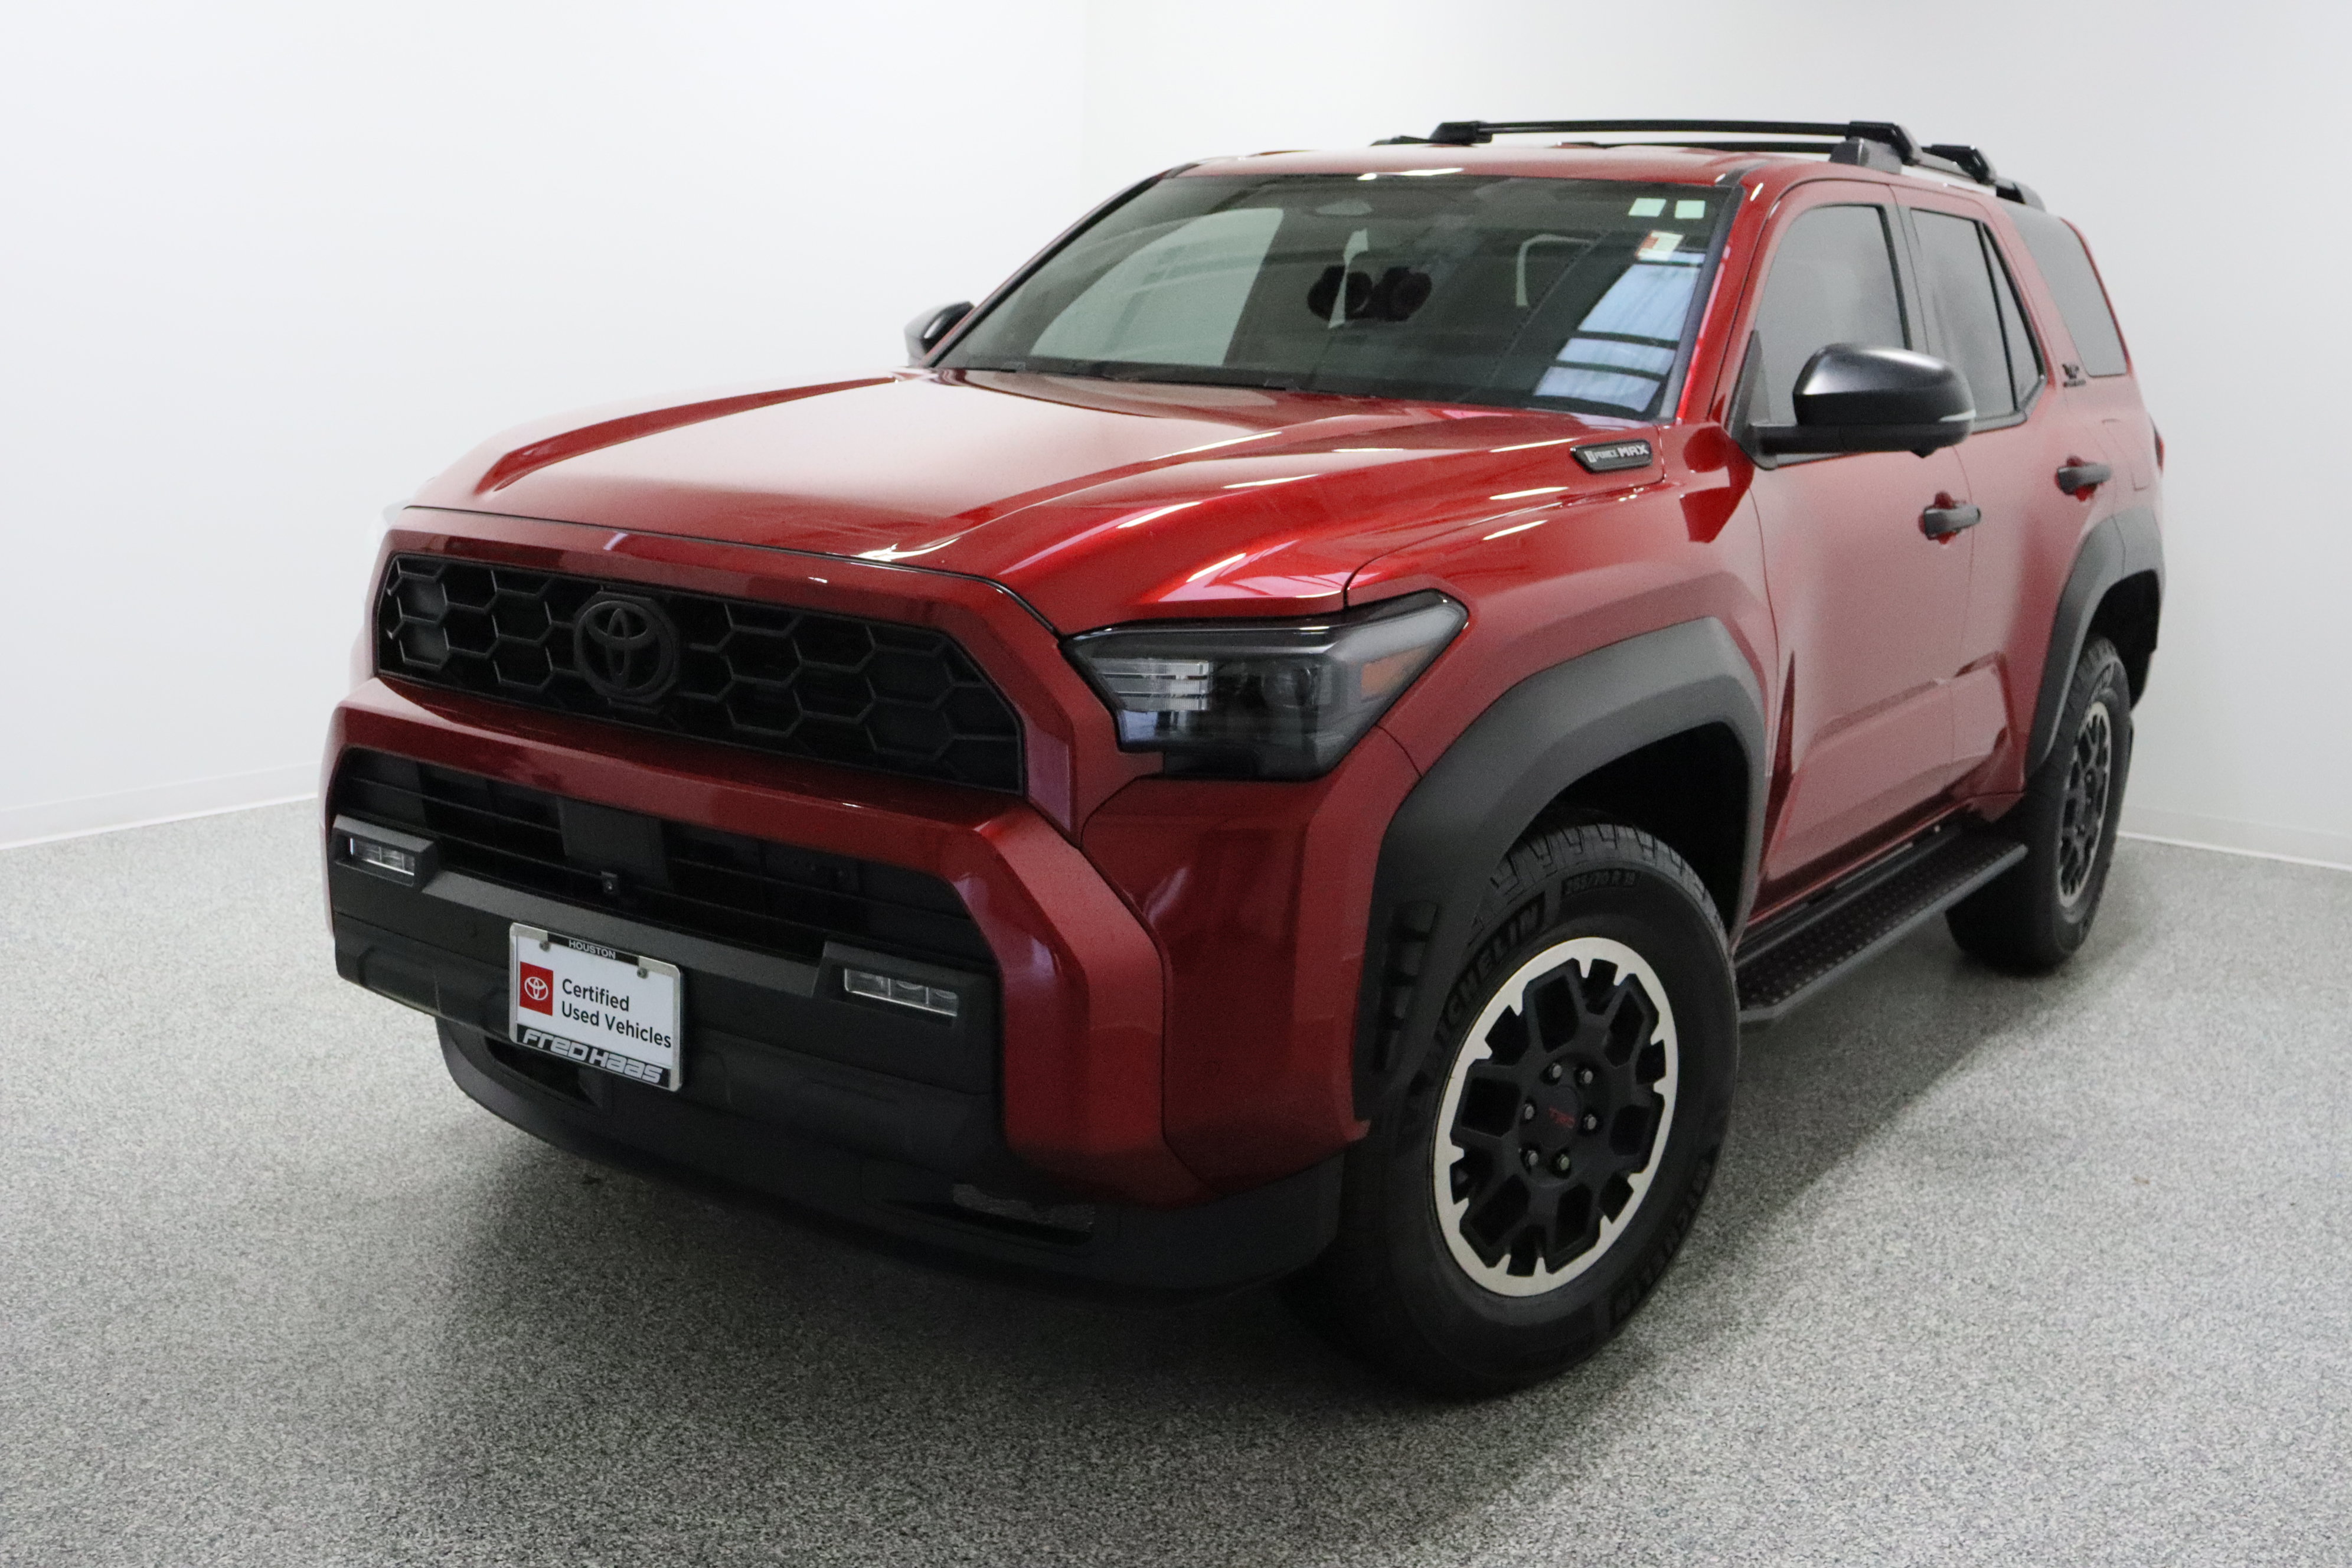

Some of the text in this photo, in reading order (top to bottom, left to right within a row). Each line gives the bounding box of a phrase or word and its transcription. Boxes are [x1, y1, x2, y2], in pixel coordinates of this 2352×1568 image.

[1616, 444, 1650, 458] MAX
[569, 939, 616, 960] HOUSTON
[561, 978, 630, 1012] Certified
[561, 1001, 672, 1048] Used Vehicles
